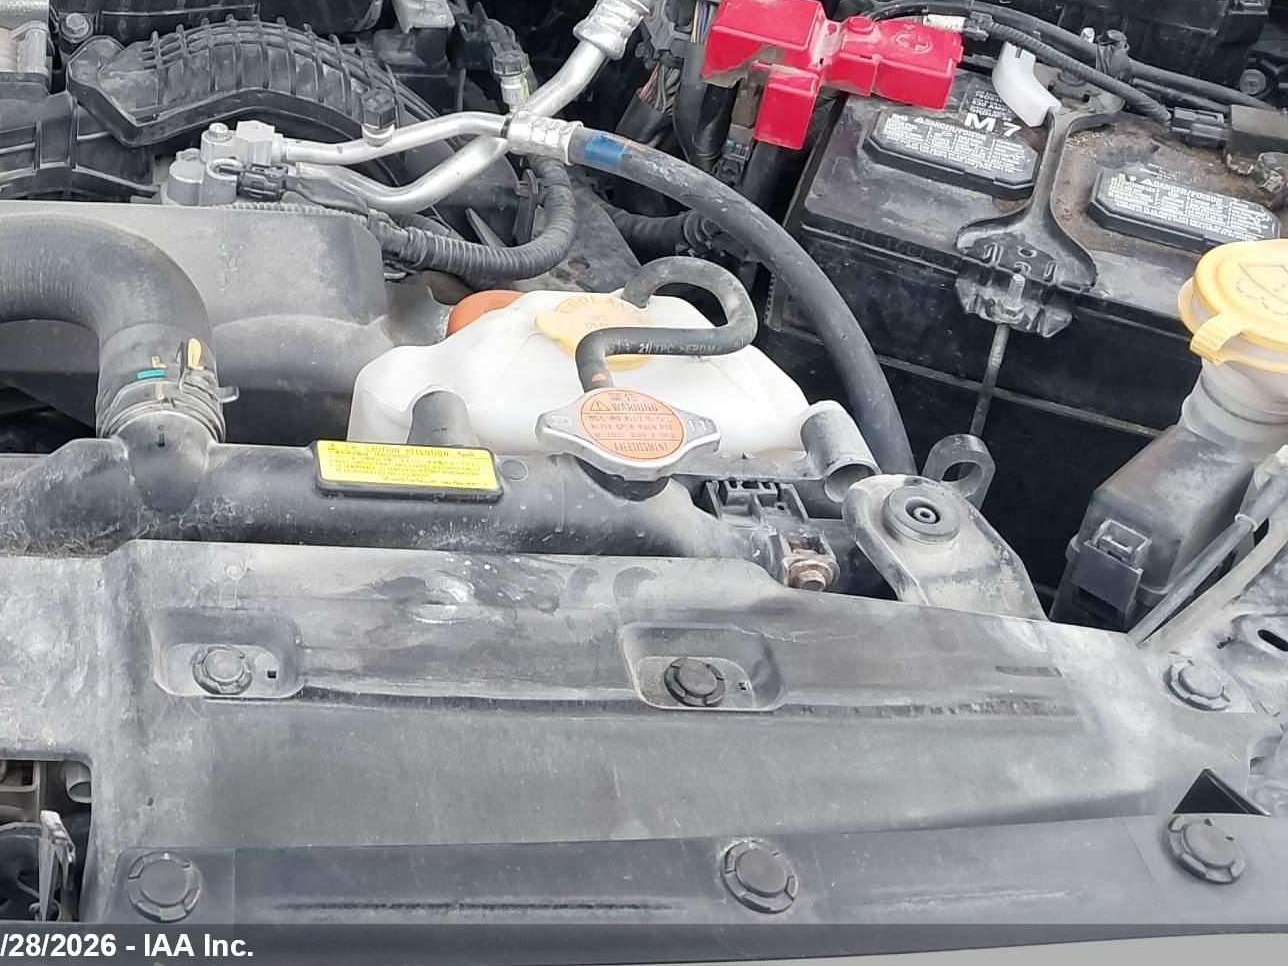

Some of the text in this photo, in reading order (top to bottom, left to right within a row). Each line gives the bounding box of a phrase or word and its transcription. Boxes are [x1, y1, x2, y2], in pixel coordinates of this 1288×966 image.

[925, 118, 987, 141] DANGER/POISON
[1153, 180, 1223, 206] DANGER/POISON
[611, 402, 658, 412] WARNING
